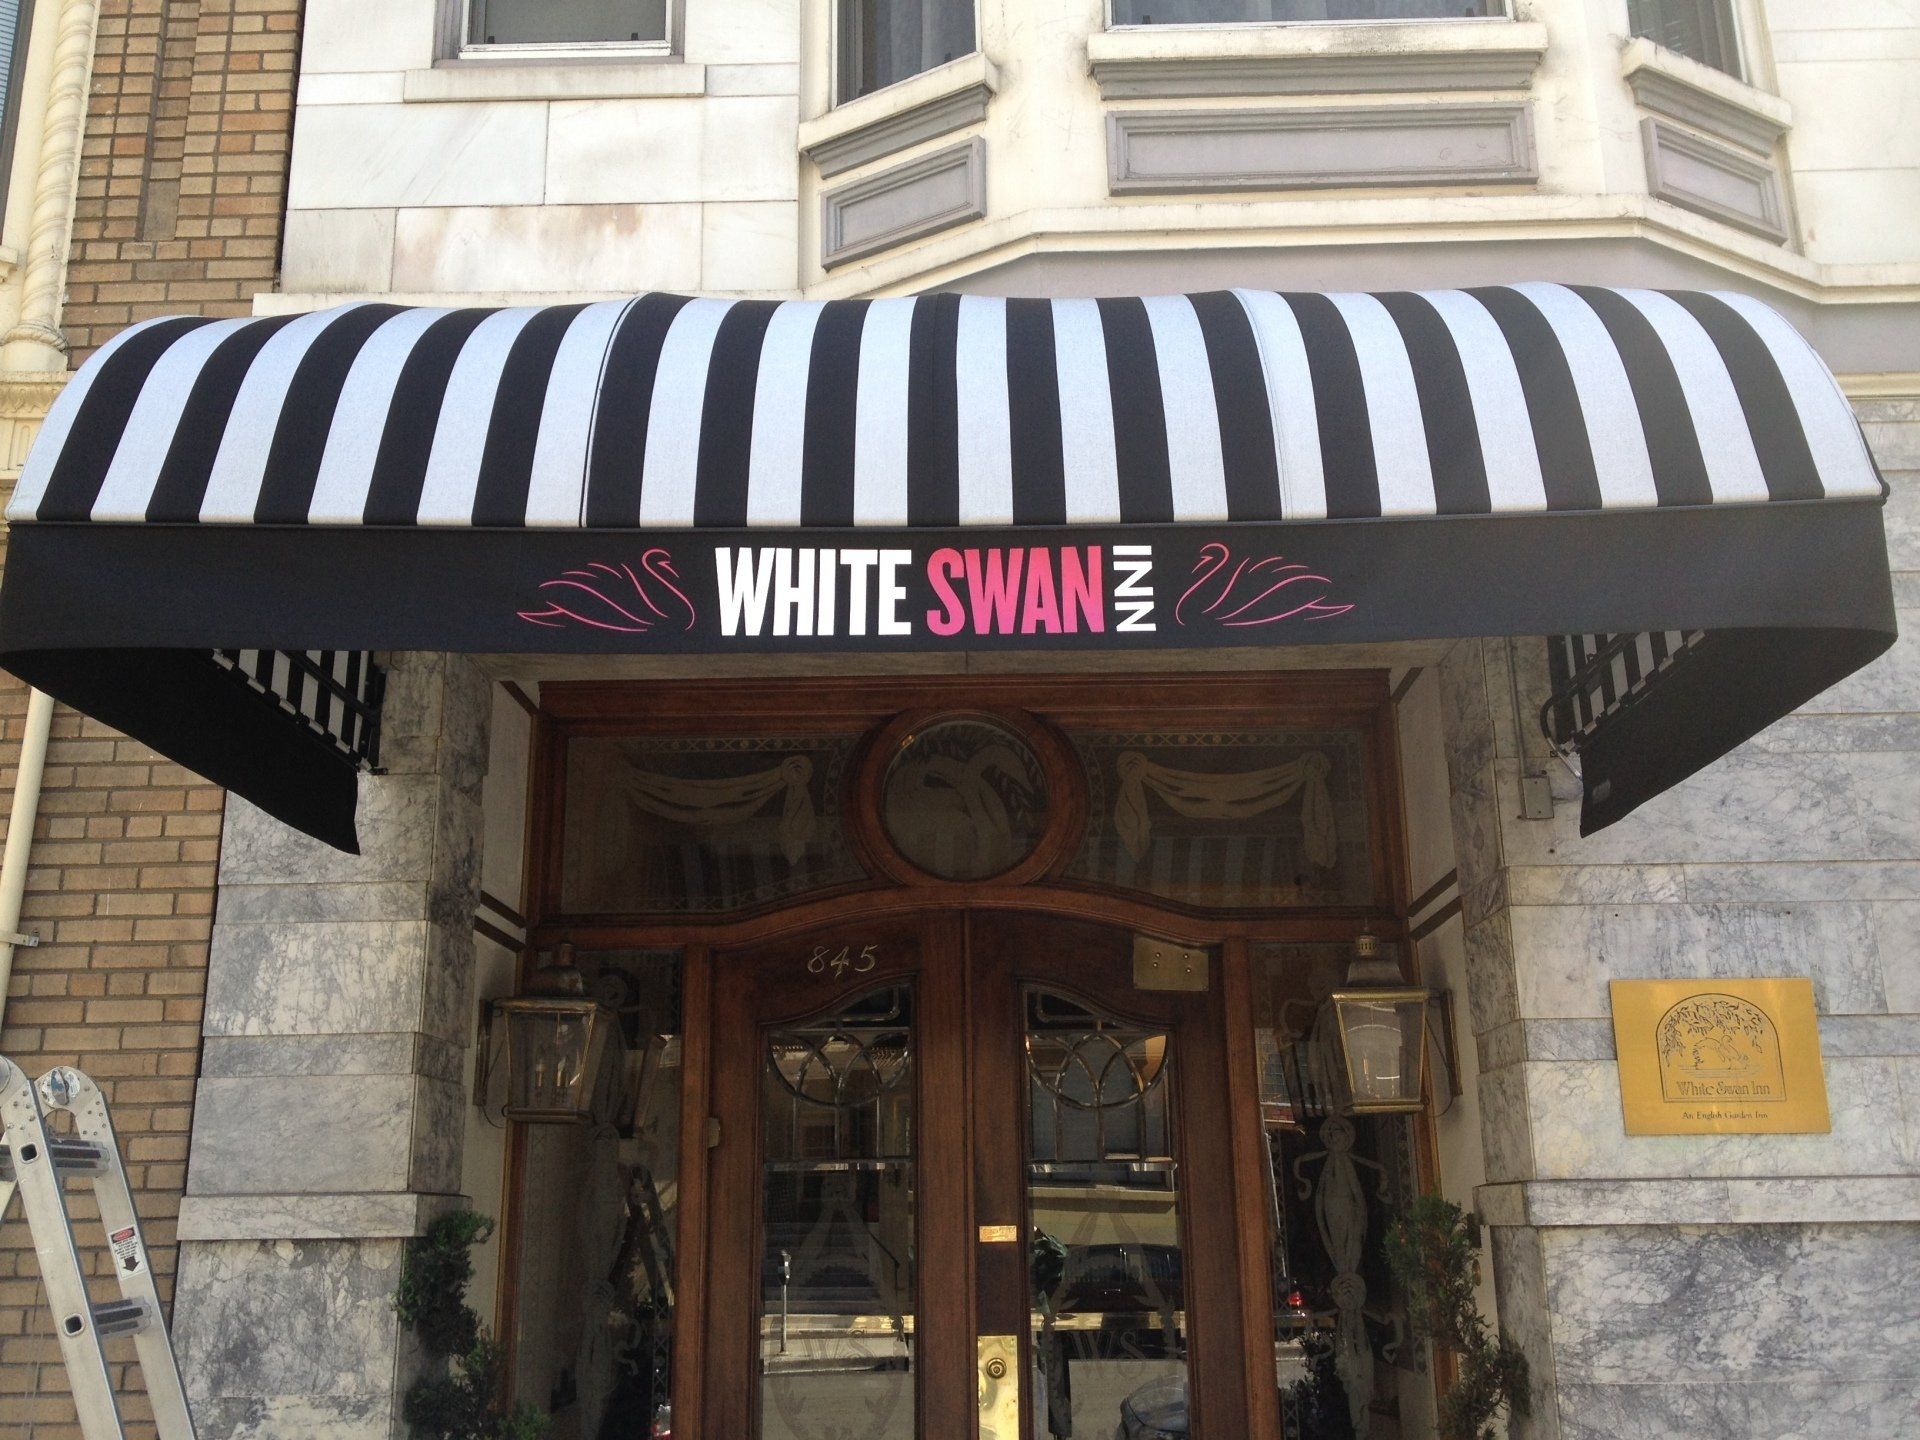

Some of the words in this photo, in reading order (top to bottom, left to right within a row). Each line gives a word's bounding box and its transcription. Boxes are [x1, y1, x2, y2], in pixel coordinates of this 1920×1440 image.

[715, 547, 912, 636] WHITE
[926, 545, 1105, 636] SWAN
[1113, 545, 1157, 632] INN
[807, 944, 879, 978] 845
[1676, 1081, 1714, 1097] White
[1716, 1081, 1749, 1096] Swan
[1751, 1081, 1770, 1095] Inn
[1682, 1111, 1694, 1120] An
[1696, 1111, 1723, 1121] English
[1725, 1111, 1753, 1120] Garden
[1755, 1111, 1768, 1119] Inn
